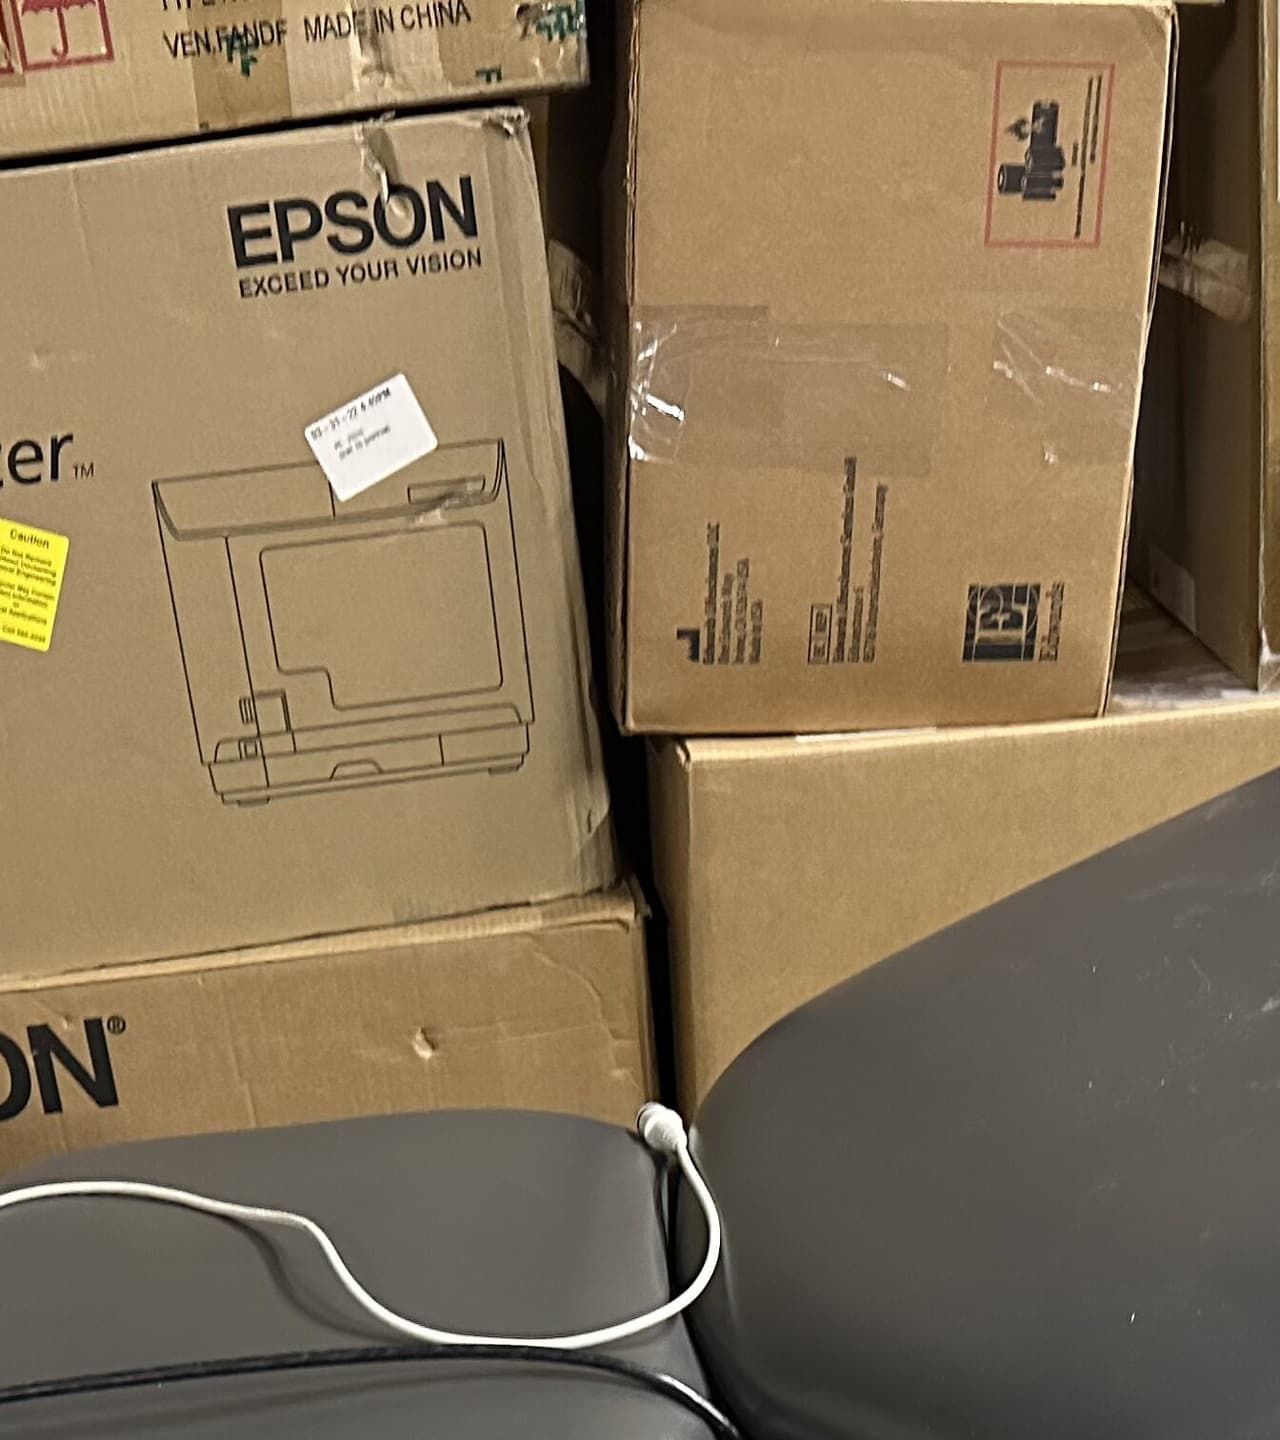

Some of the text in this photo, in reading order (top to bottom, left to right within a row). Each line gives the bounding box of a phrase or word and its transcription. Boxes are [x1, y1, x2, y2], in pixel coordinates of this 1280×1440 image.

[304, 8, 366, 42] MADE
[373, 7, 394, 33] IN
[400, 0, 472, 30] CHINA
[228, 176, 478, 268] EPSON
[239, 247, 482, 298] EXCEED YOUR VISION
[10, 529, 50, 549] Caution
[1039, 581, 1064, 663] Edwards
